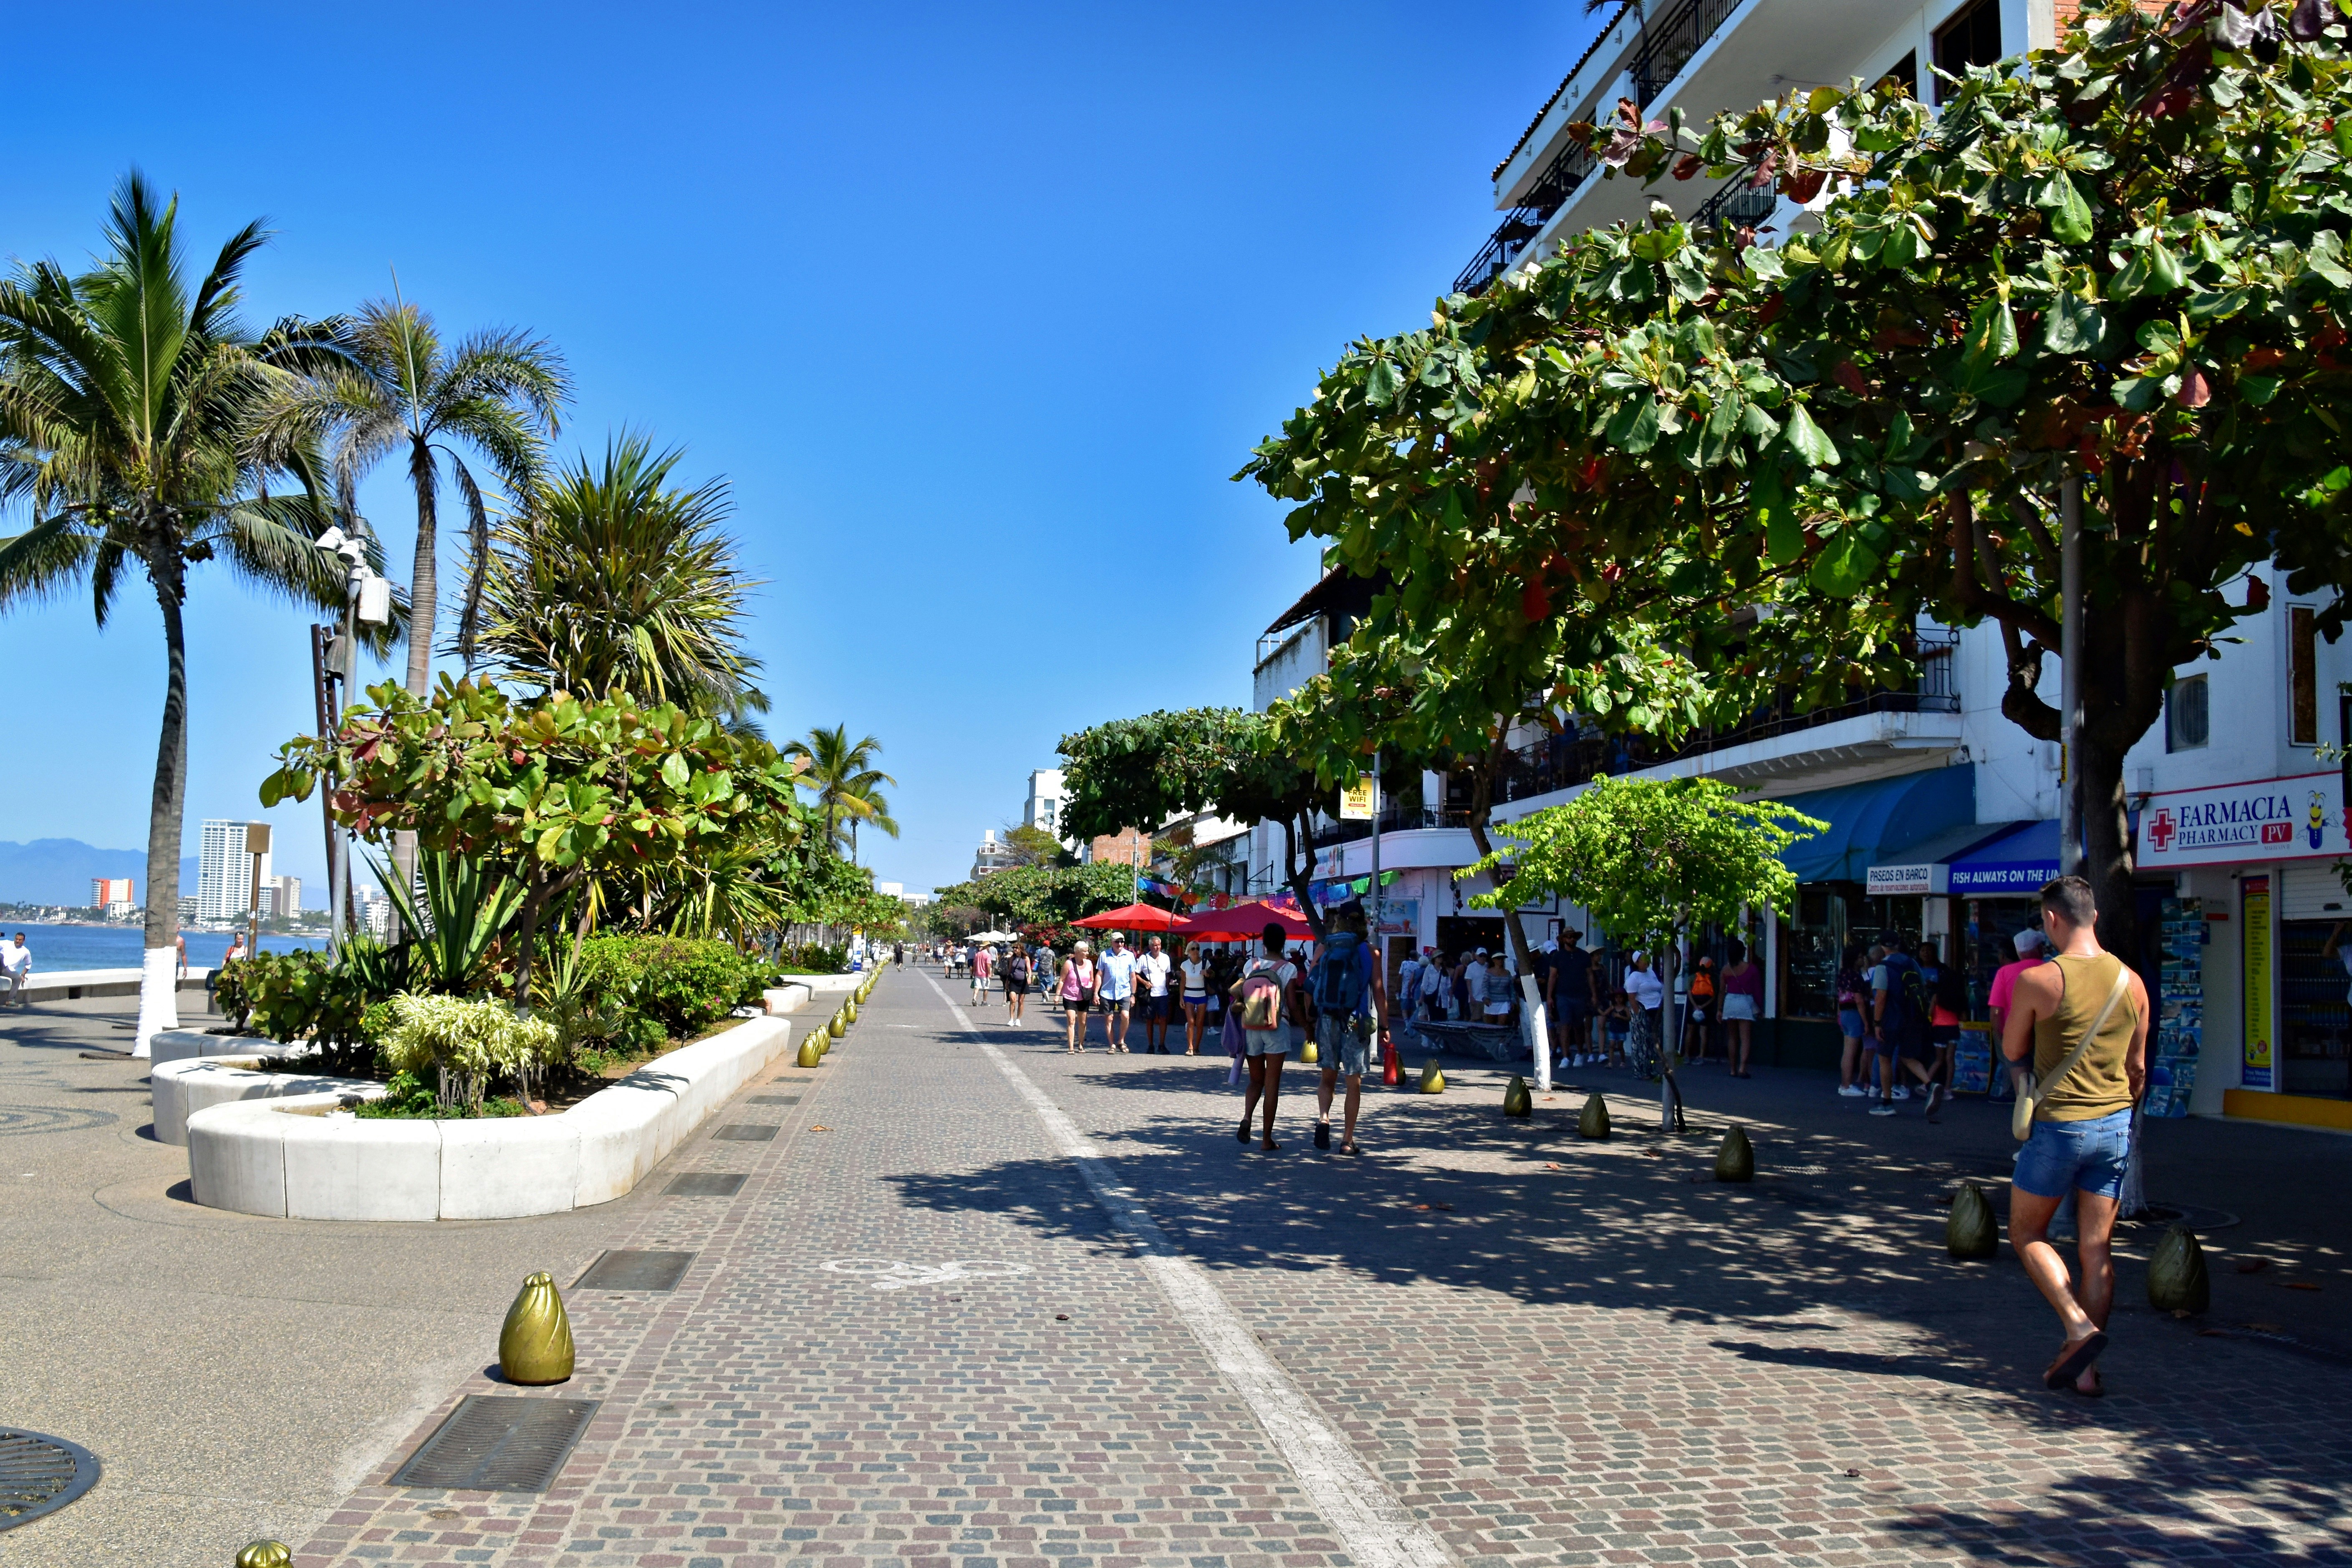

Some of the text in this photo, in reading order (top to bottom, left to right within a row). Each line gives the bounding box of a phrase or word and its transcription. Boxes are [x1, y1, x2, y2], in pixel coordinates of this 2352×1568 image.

[2179, 795, 2292, 828] FARMACIA
[2179, 825, 2258, 845] PHARMACY
[2268, 825, 2286, 841] PV
[1870, 868, 1928, 881] PASEOS EN BARCO
[1953, 872, 1970, 884] FISH
[1972, 871, 2007, 883] ALWAYS
[2009, 870, 2024, 882] ON
[2027, 869, 2044, 881] THE
